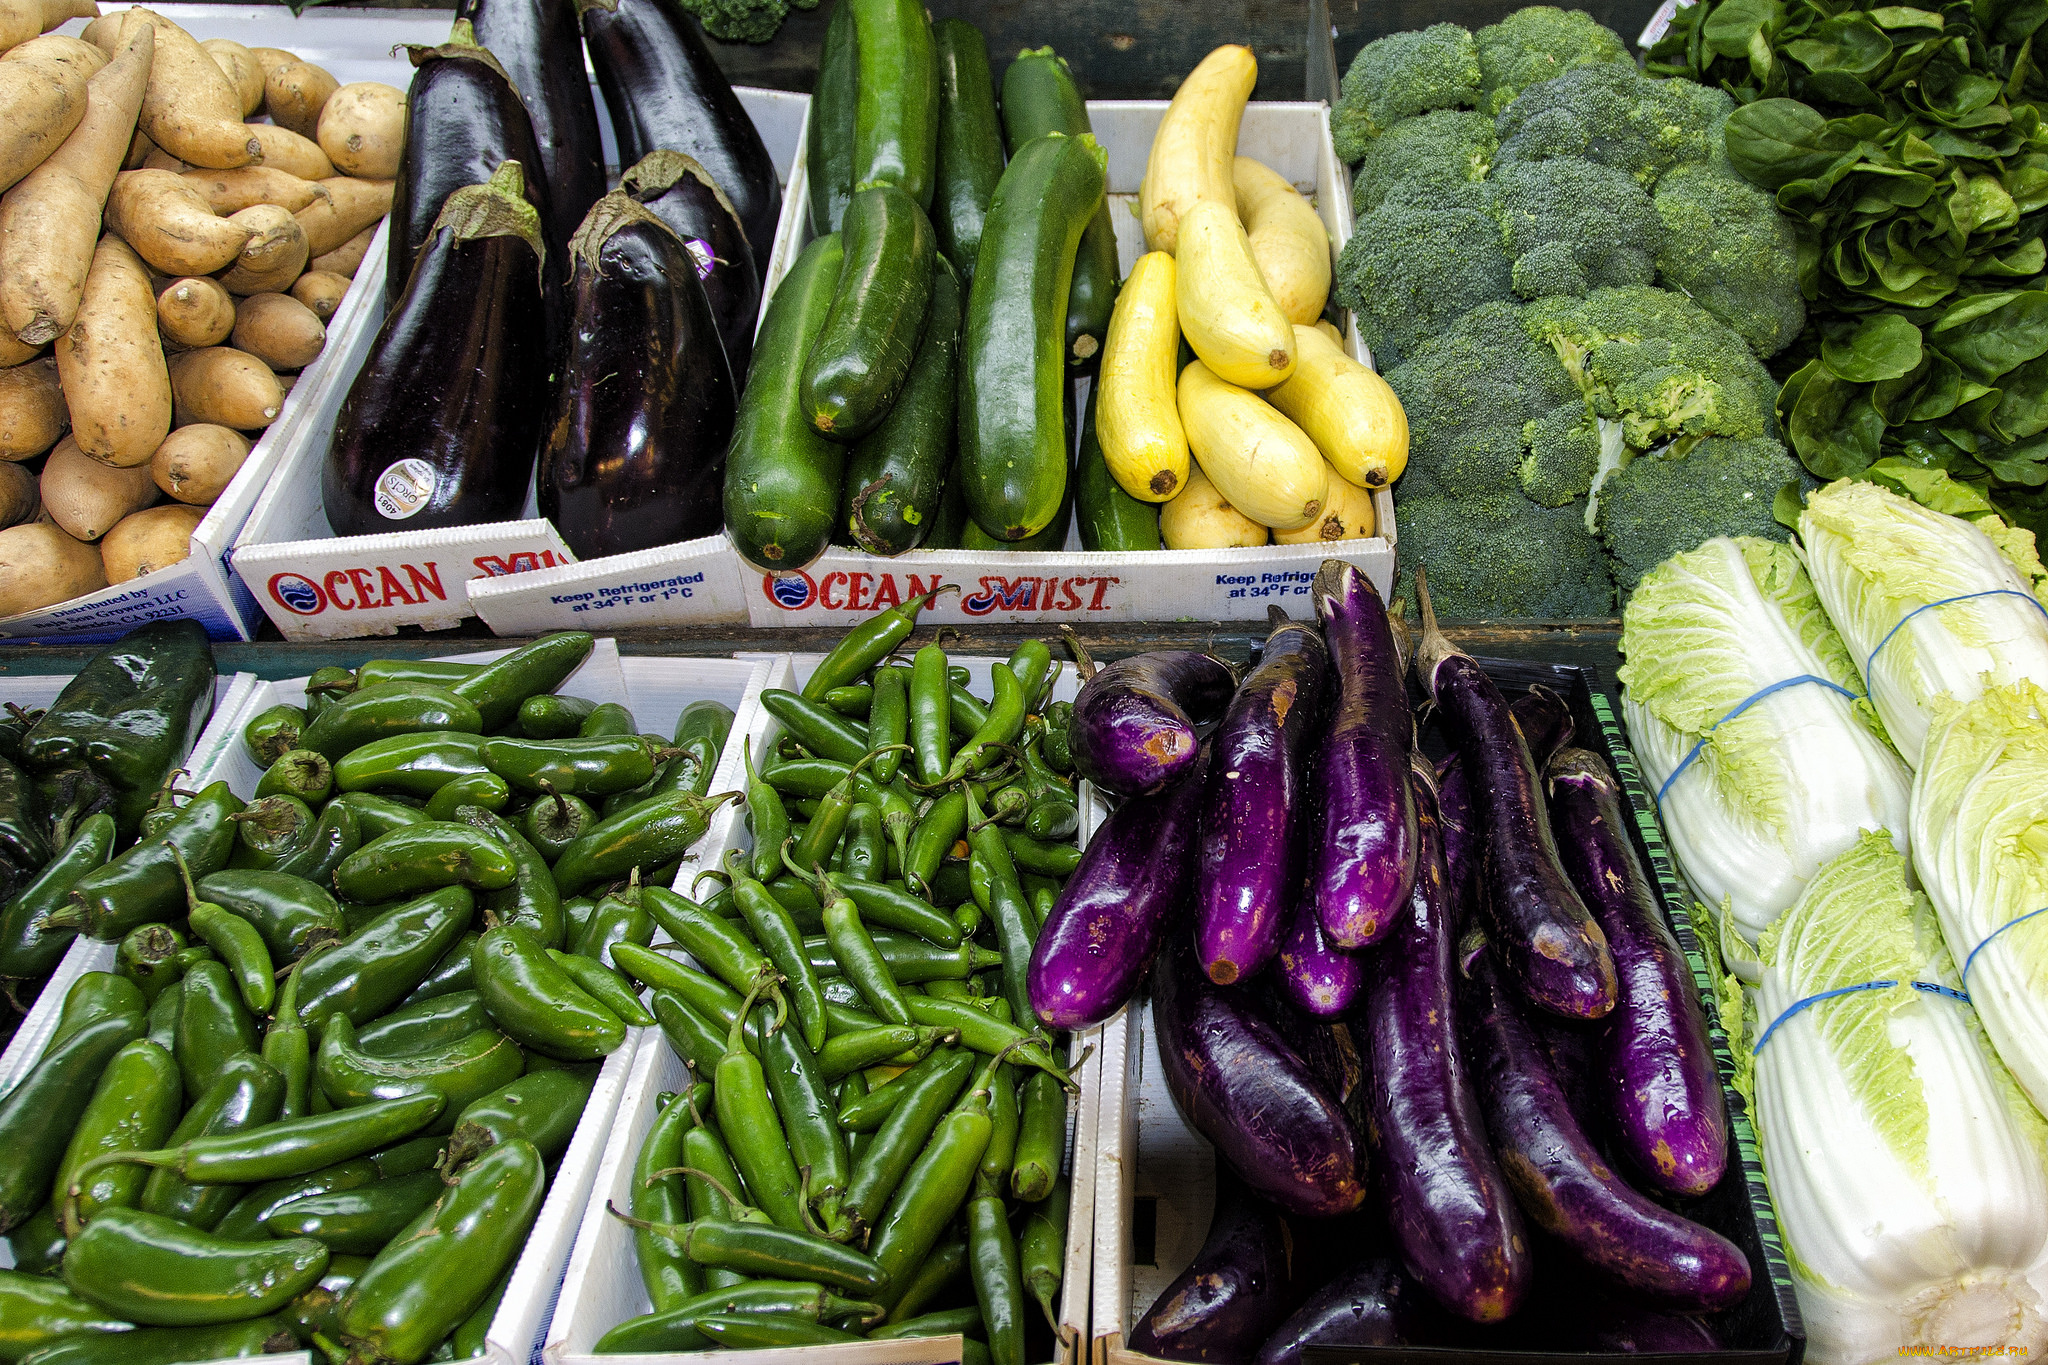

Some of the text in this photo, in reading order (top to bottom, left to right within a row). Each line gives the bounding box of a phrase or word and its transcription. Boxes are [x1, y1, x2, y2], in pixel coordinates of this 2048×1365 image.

[388, 476, 418, 503] ORCIS
[377, 495, 397, 514] 4081
[267, 561, 447, 616] OCEAN
[550, 571, 704, 605] Keep Refrigerated
[1216, 571, 1317, 586] Keep Refrige
[51, 588, 148, 618] Distributed by
[572, 602, 590, 612] at
[639, 593, 656, 603] or
[762, 568, 1120, 617] OCEAN MIST
[1230, 588, 1246, 598] at
[68, 613, 95, 625] Son
[96, 599, 154, 618] Growers
[154, 589, 189, 605] LLC
[121, 613, 146, 625] CA
[145, 605, 184, 619] 92231
